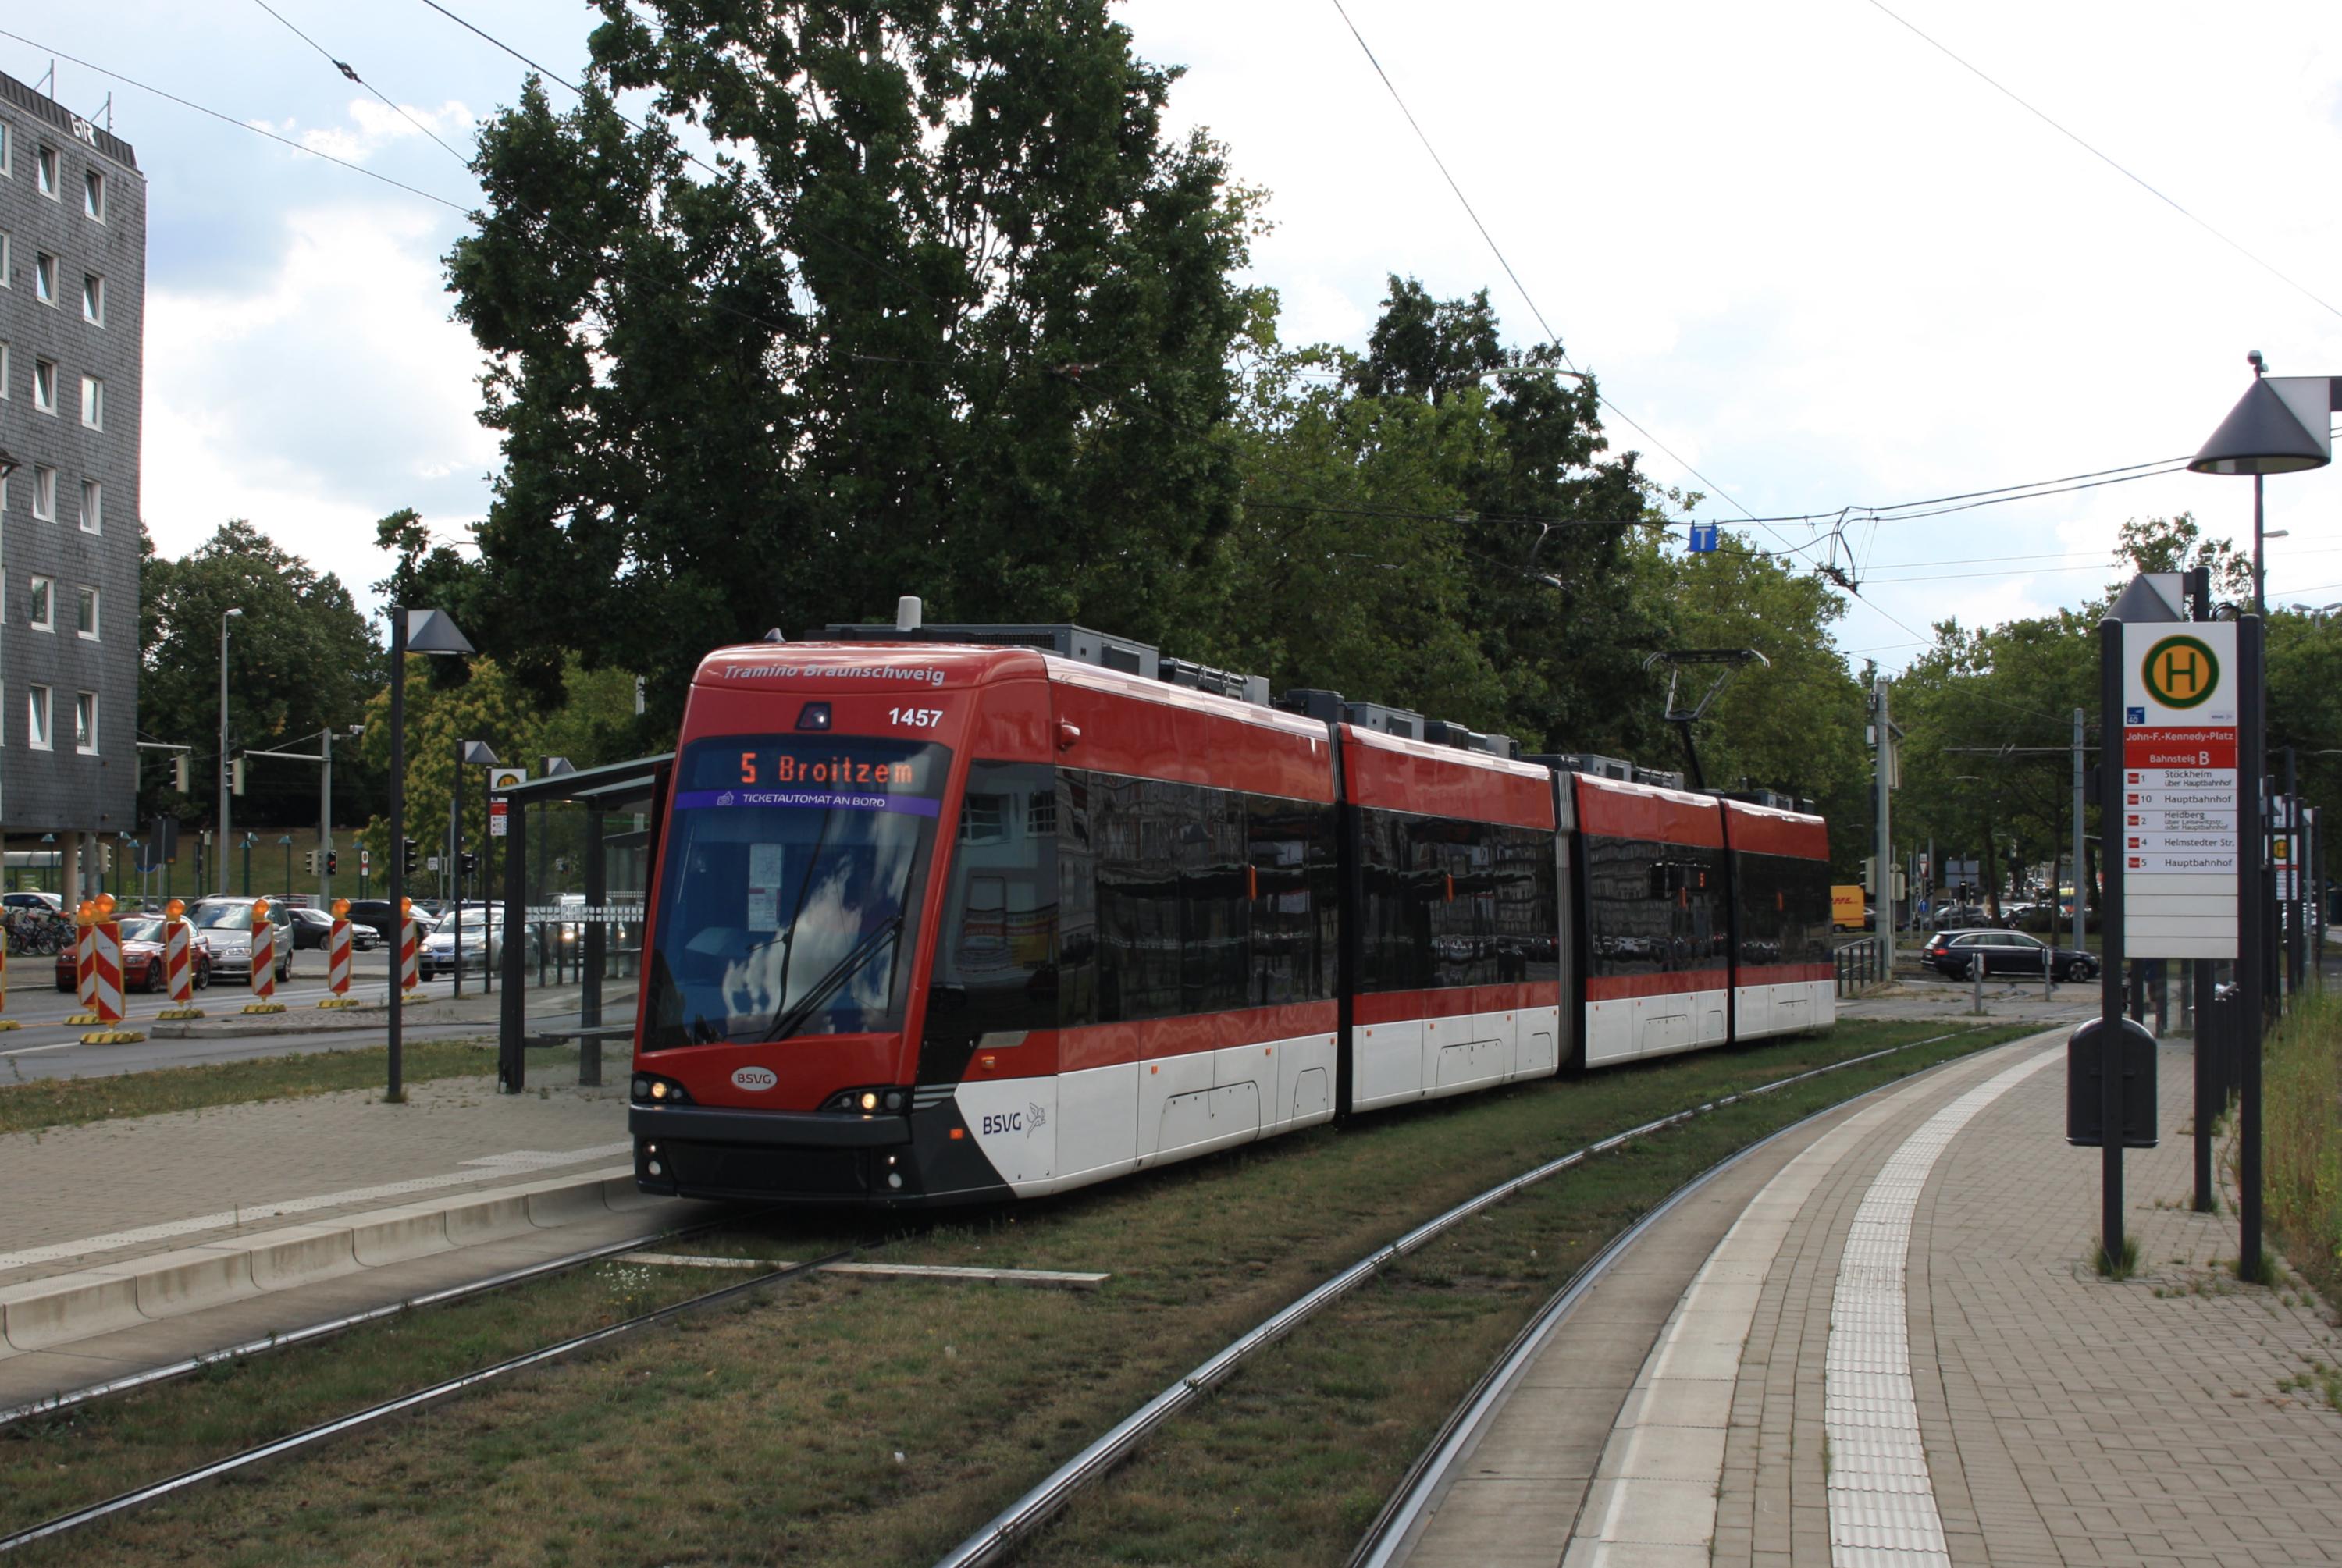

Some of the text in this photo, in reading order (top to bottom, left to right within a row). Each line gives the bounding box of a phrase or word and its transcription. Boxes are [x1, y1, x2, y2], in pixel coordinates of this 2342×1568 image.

[1695, 527, 1711, 549] T
[724, 664, 945, 685] Tramino Braunschweig
[2166, 652, 2196, 692] H
[888, 707, 943, 727] 1457
[2126, 732, 2234, 741] John-F.-Kennedy-Platz
[2149, 751, 2209, 765] Bahnsteig B
[741, 752, 912, 783] 5 Broitzem
[743, 793, 830, 805] TICKETAUTOMAT
[852, 798, 885, 807] BORD
[2164, 795, 2231, 805] Hauptbahnhof
[2165, 859, 2232, 867] Hauptbahnhof
[738, 1074, 771, 1084] BSVG
[983, 1112, 1022, 1135] BSVG
